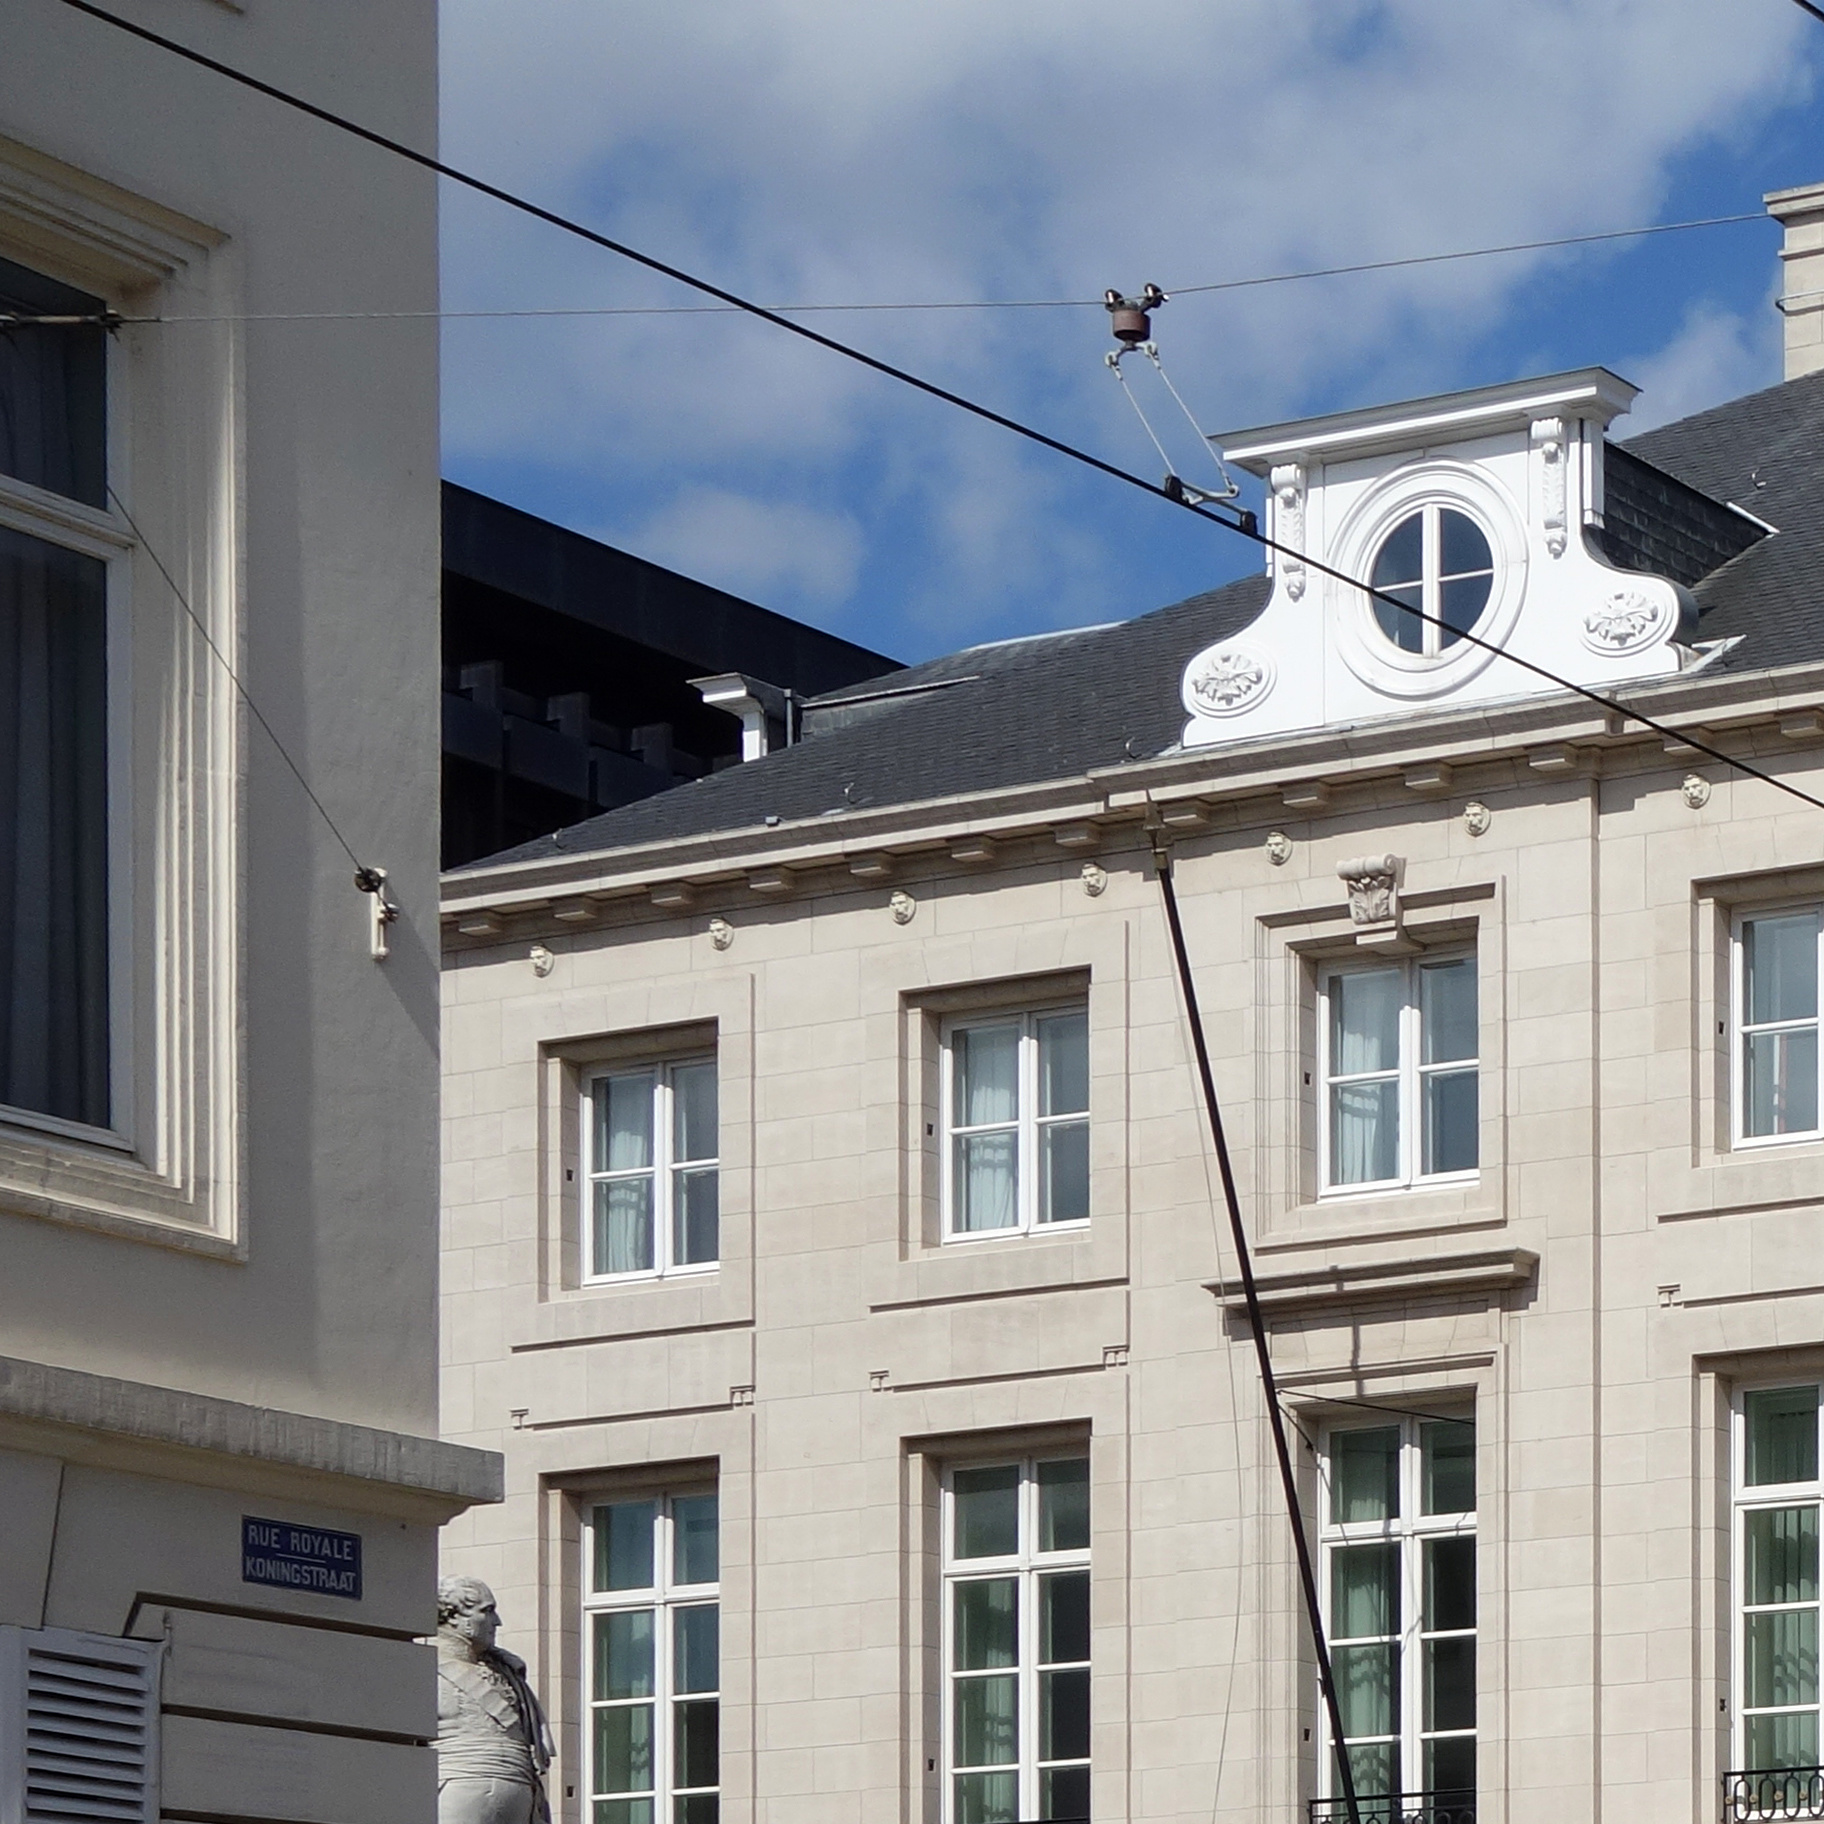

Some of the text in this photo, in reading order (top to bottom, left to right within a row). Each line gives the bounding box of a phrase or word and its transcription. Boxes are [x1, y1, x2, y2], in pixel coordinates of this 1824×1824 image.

[248, 1525, 353, 1560] RUE ROYALE
[246, 1556, 356, 1592] KONINGSTRAAT
